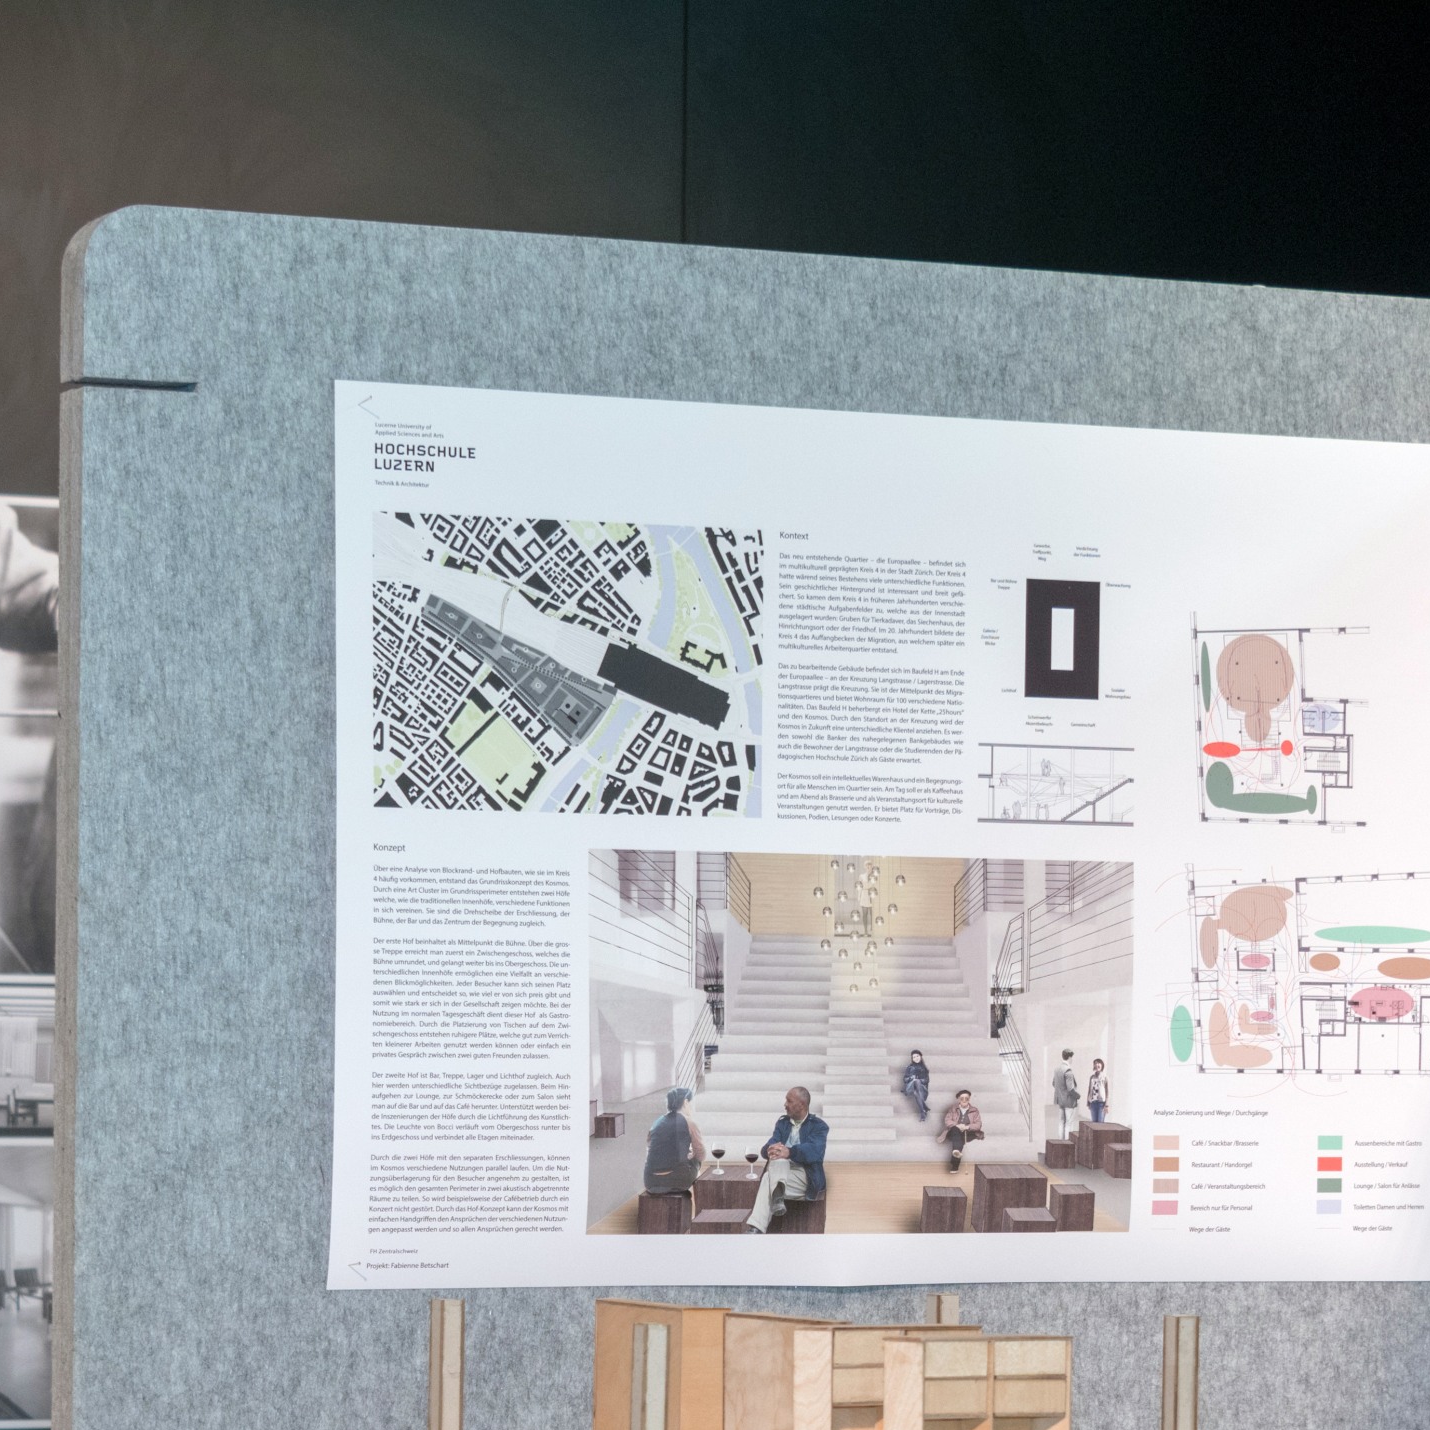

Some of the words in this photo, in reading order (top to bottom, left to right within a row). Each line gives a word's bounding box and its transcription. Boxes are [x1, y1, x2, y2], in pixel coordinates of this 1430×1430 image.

[397, 423, 425, 431] University
[374, 443, 476, 458] HOCHSCHULE
[374, 458, 435, 472] LUZERN
[779, 531, 809, 540] Kontext
[777, 803, 825, 811] Veranstaltungen
[831, 815, 859, 823] Lesungen
[373, 843, 406, 853] Konzept
[404, 866, 428, 874] Analyse
[1153, 1109, 1174, 1117] Analyse
[1175, 1109, 1203, 1117] Zonierung
[1235, 1109, 1269, 1117] Durchgänge
[1354, 1161, 1385, 1169] Ausstellung
[400, 1215, 437, 1224] Handgriffen
[450, 1215, 487, 1223] Ansprüchen
[1352, 1225, 1367, 1233] Wege
[366, 1262, 389, 1270] Projekt:
